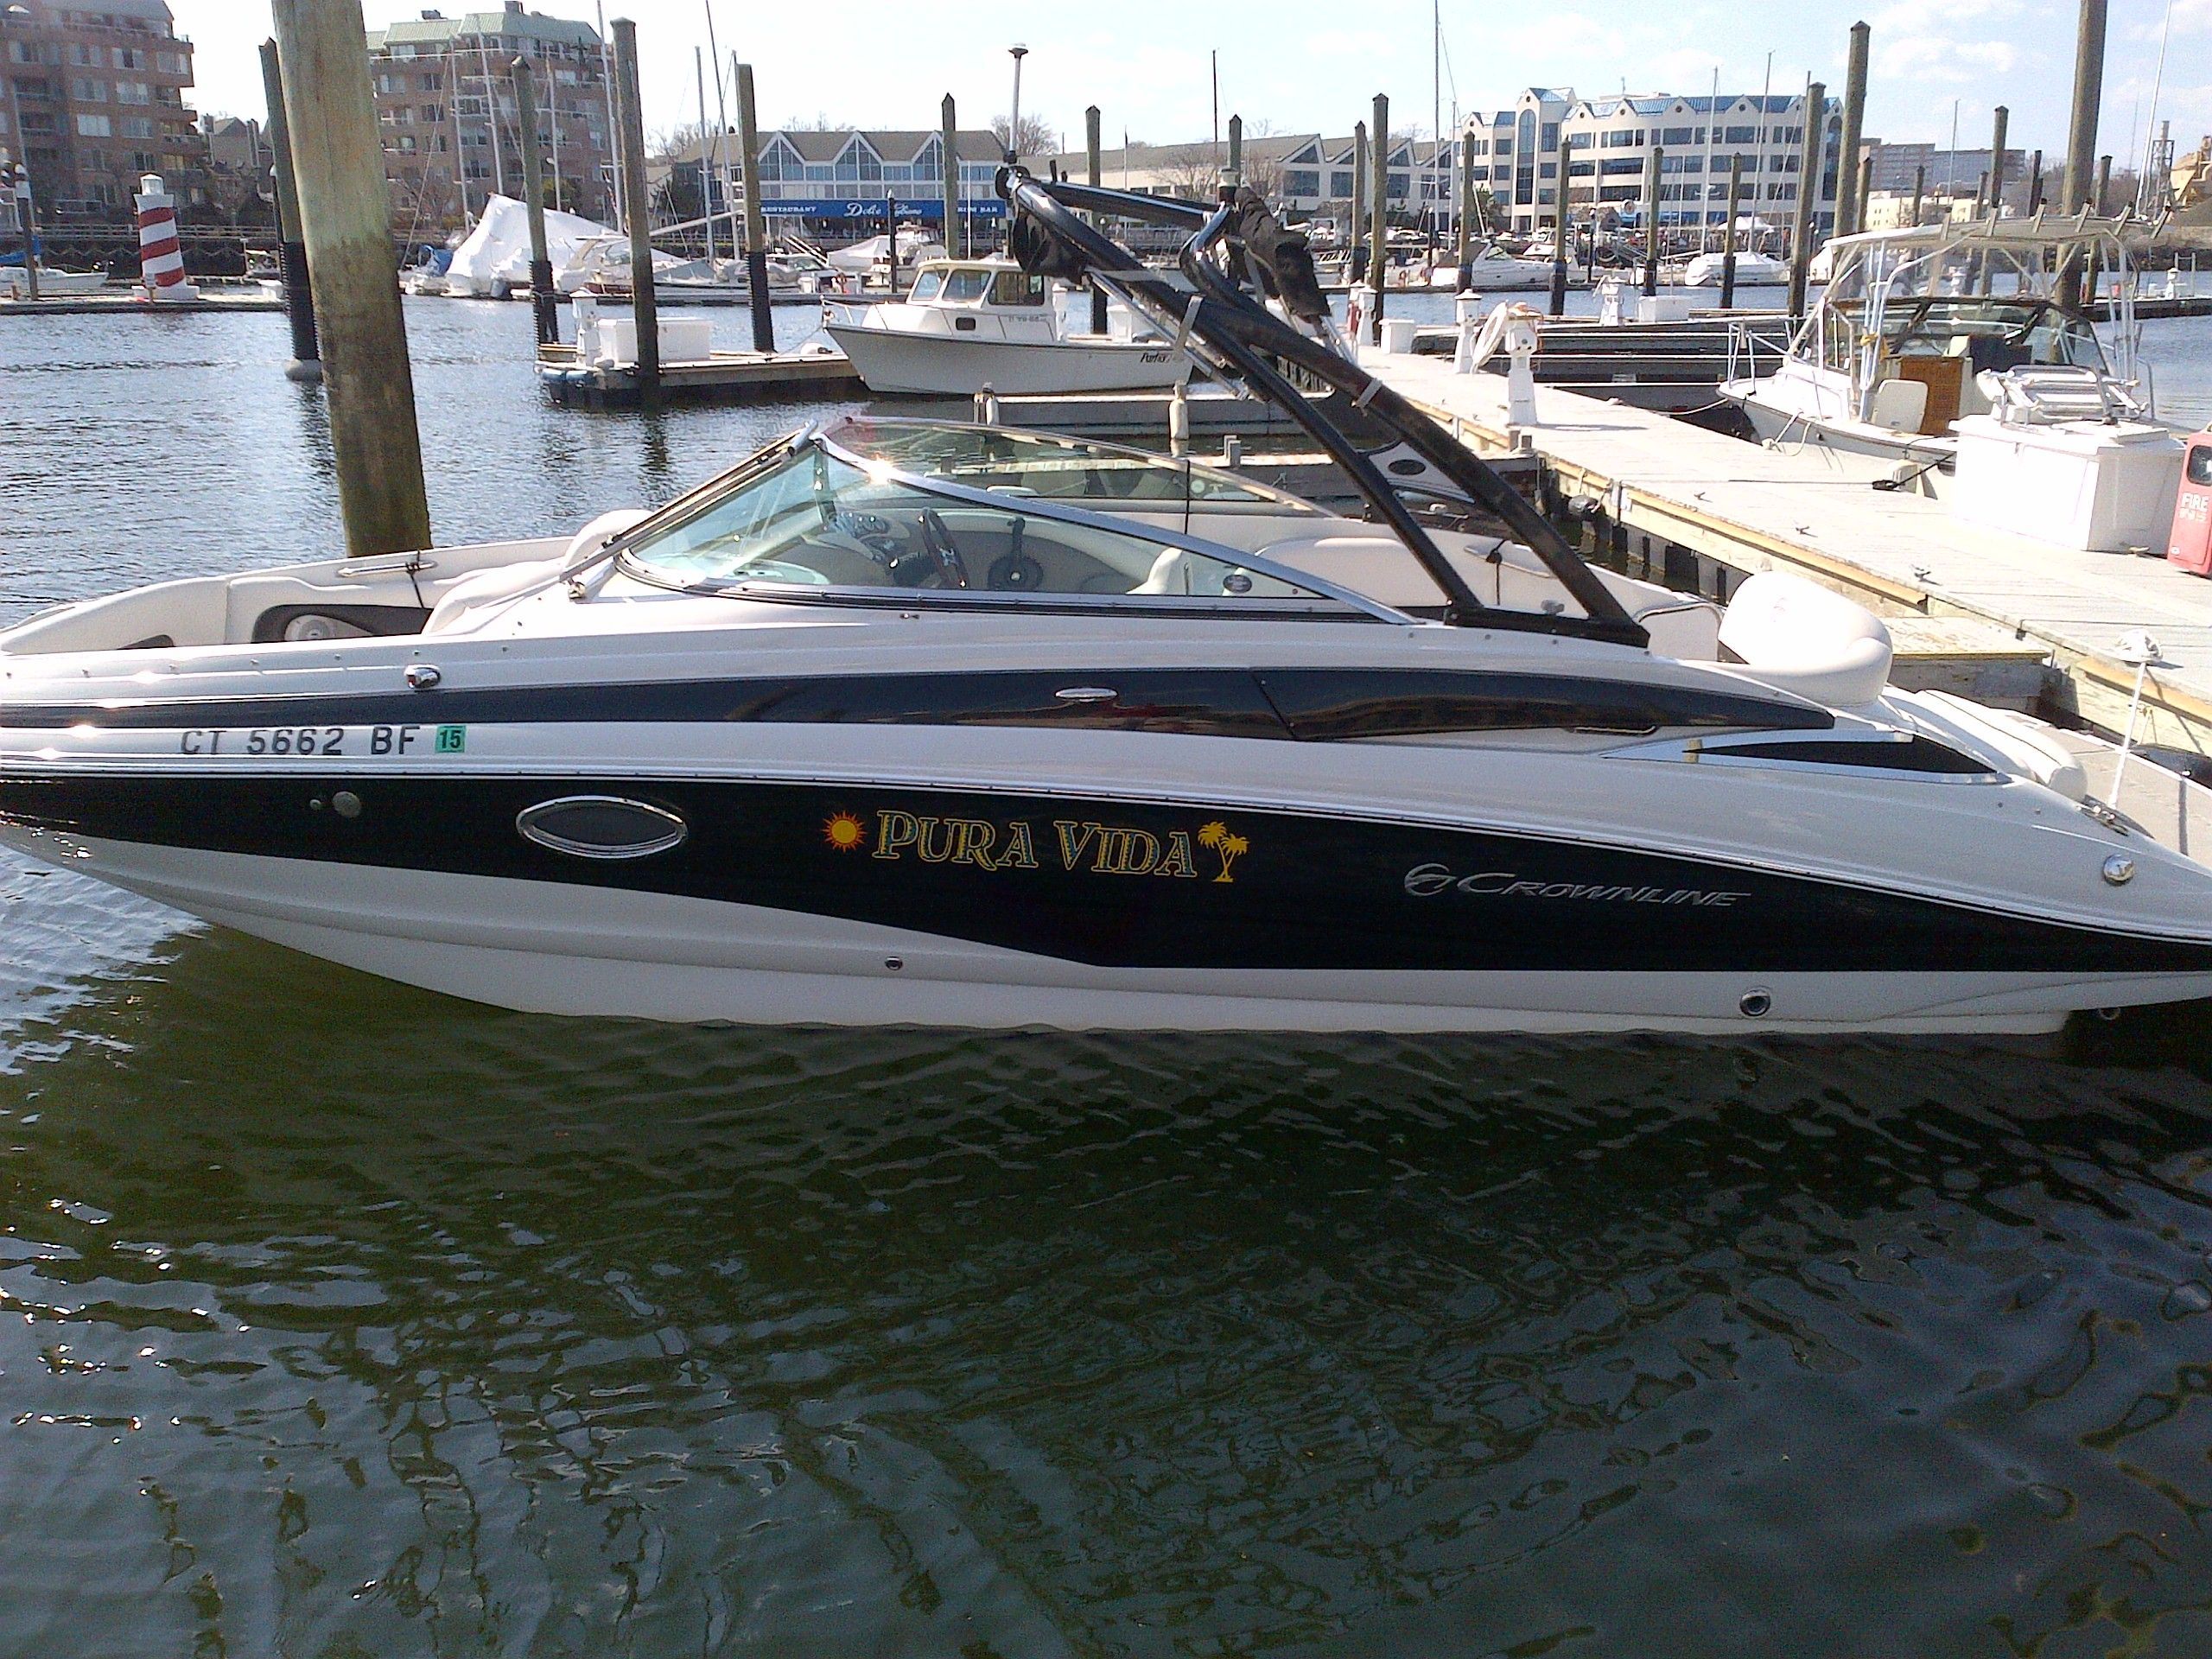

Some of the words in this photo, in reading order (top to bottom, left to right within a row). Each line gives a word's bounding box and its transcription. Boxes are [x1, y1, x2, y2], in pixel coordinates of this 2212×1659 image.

[2181, 492, 2209, 512] FIRE
[180, 729, 227, 755] CT
[246, 728, 345, 756] 5662
[371, 725, 422, 755] BF
[439, 729, 461, 749] 15
[872, 810, 1039, 871] PURA
[1053, 820, 1198, 878] VIDA
[1457, 872, 1752, 906] CROWNLINE
